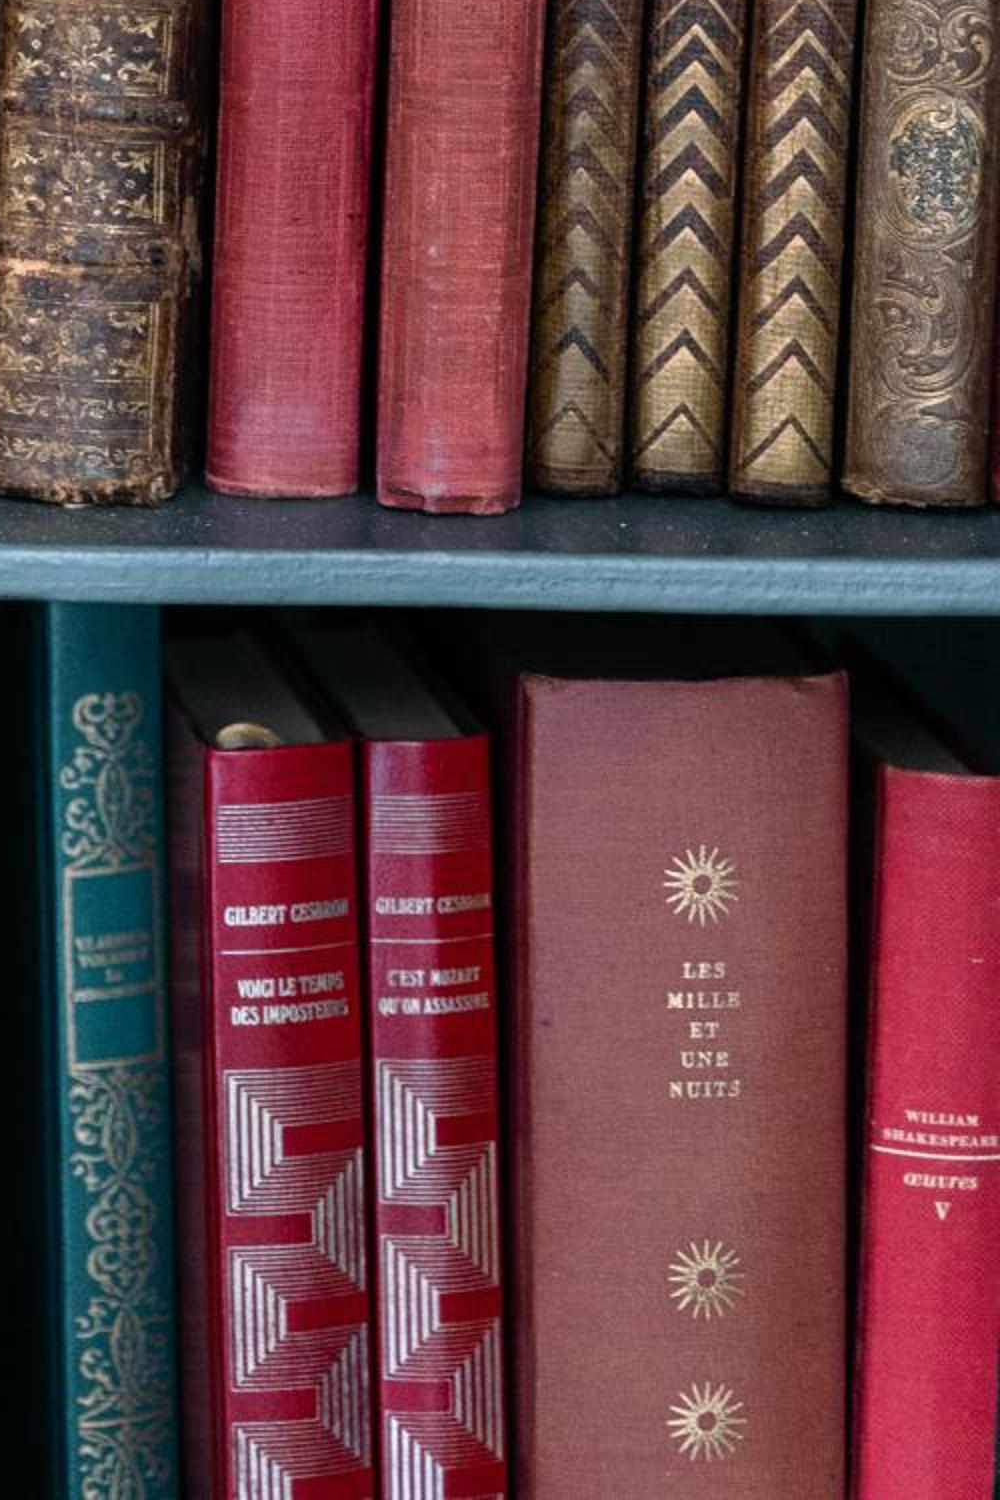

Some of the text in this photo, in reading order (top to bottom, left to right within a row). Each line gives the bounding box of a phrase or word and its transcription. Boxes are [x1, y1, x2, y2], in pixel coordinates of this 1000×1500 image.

[375, 896, 434, 915] GILBERT
[224, 905, 287, 927] GILBERT
[681, 961, 725, 979] LES
[278, 976, 296, 996] LE
[666, 991, 741, 1009] MILLE
[231, 1005, 259, 1026] DES
[688, 1021, 719, 1039] ET
[680, 1051, 729, 1068] UNE
[668, 1080, 741, 1099] NUITS
[905, 1109, 979, 1127] WILLIAM
[935, 1201, 951, 1220] V
